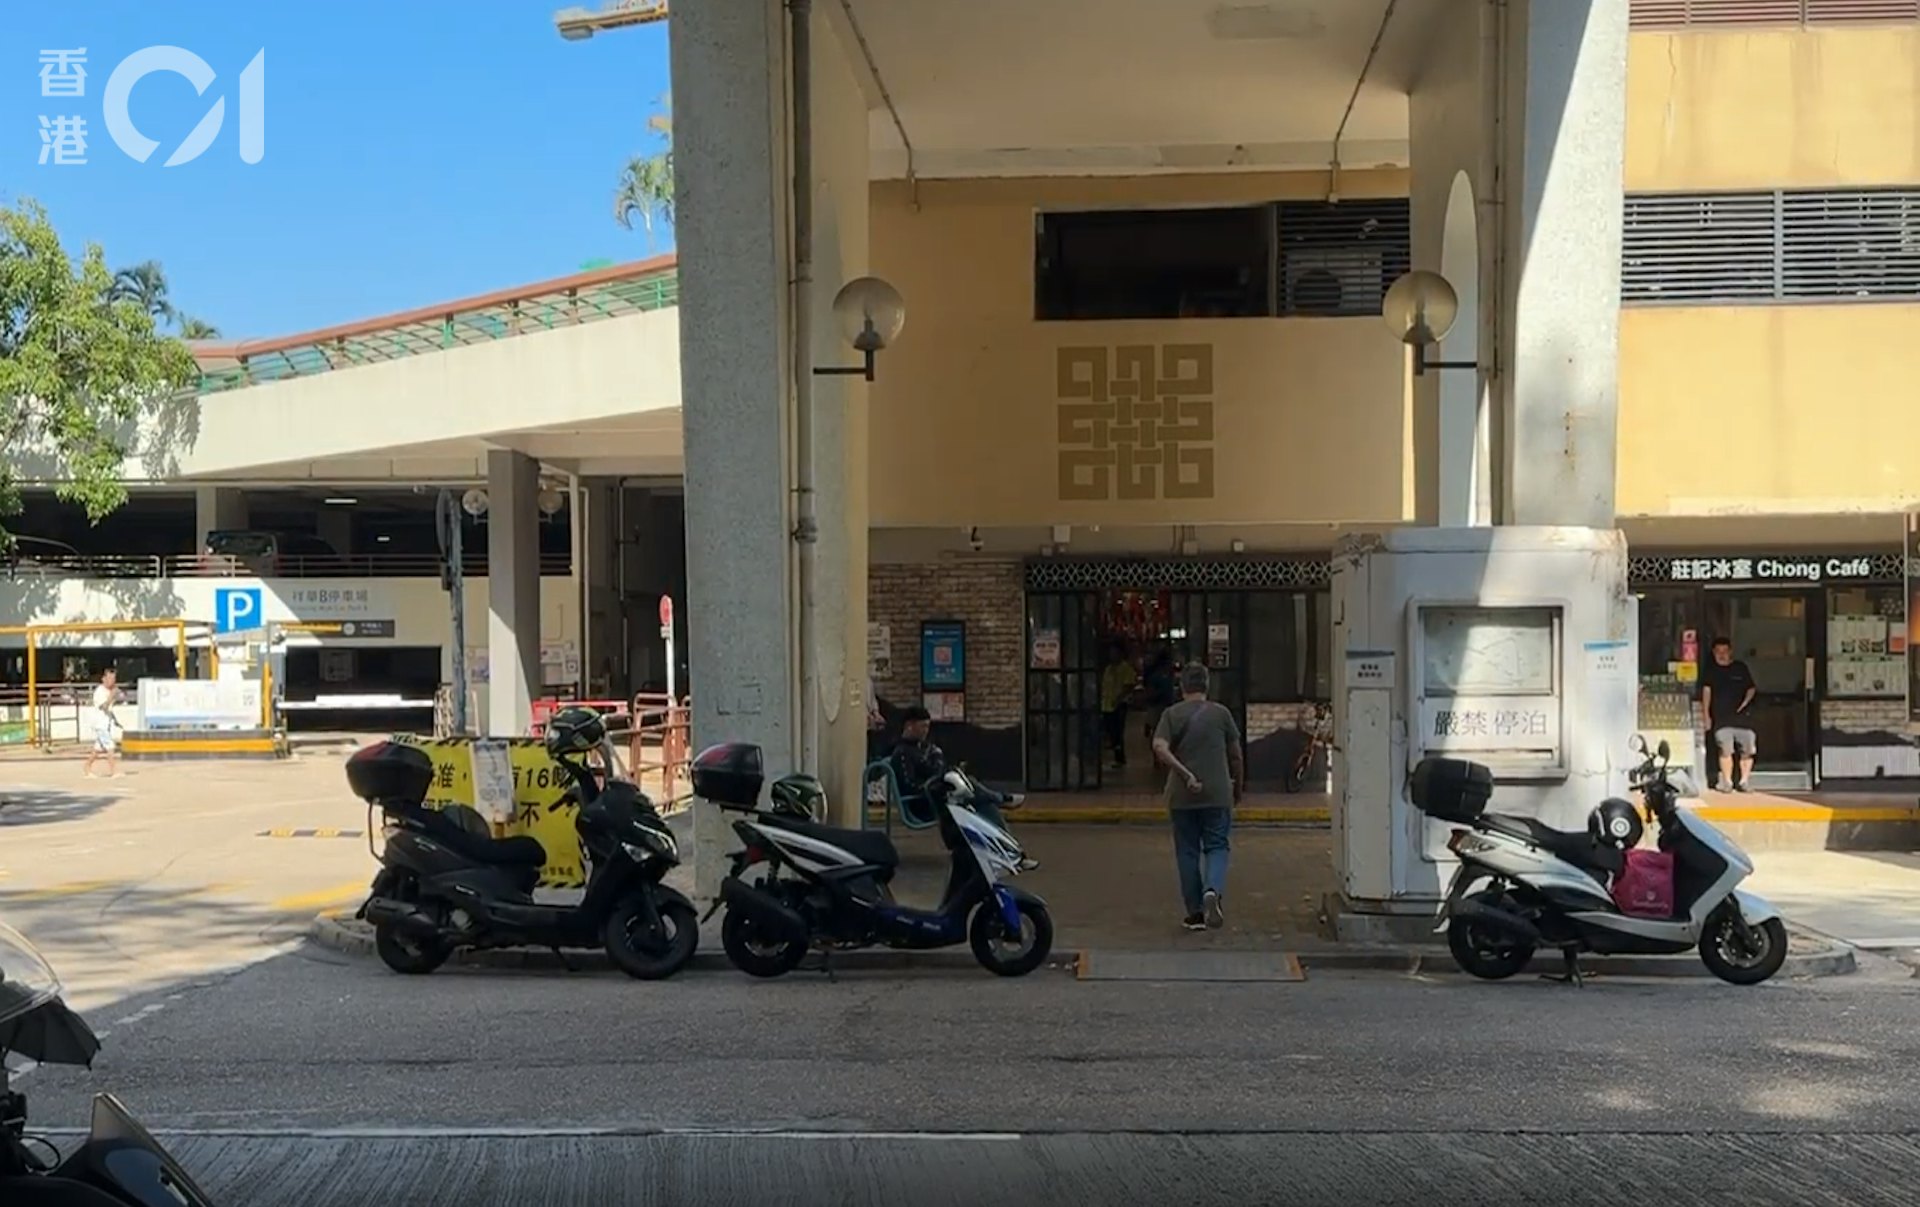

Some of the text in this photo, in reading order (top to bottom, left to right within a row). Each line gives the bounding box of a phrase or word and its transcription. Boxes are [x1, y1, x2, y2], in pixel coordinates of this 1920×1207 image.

[1757, 560, 1821, 580] Chong
[1826, 558, 1870, 576] Café
[227, 591, 253, 631] P
[1433, 710, 1547, 737] 嚴禁停泊
